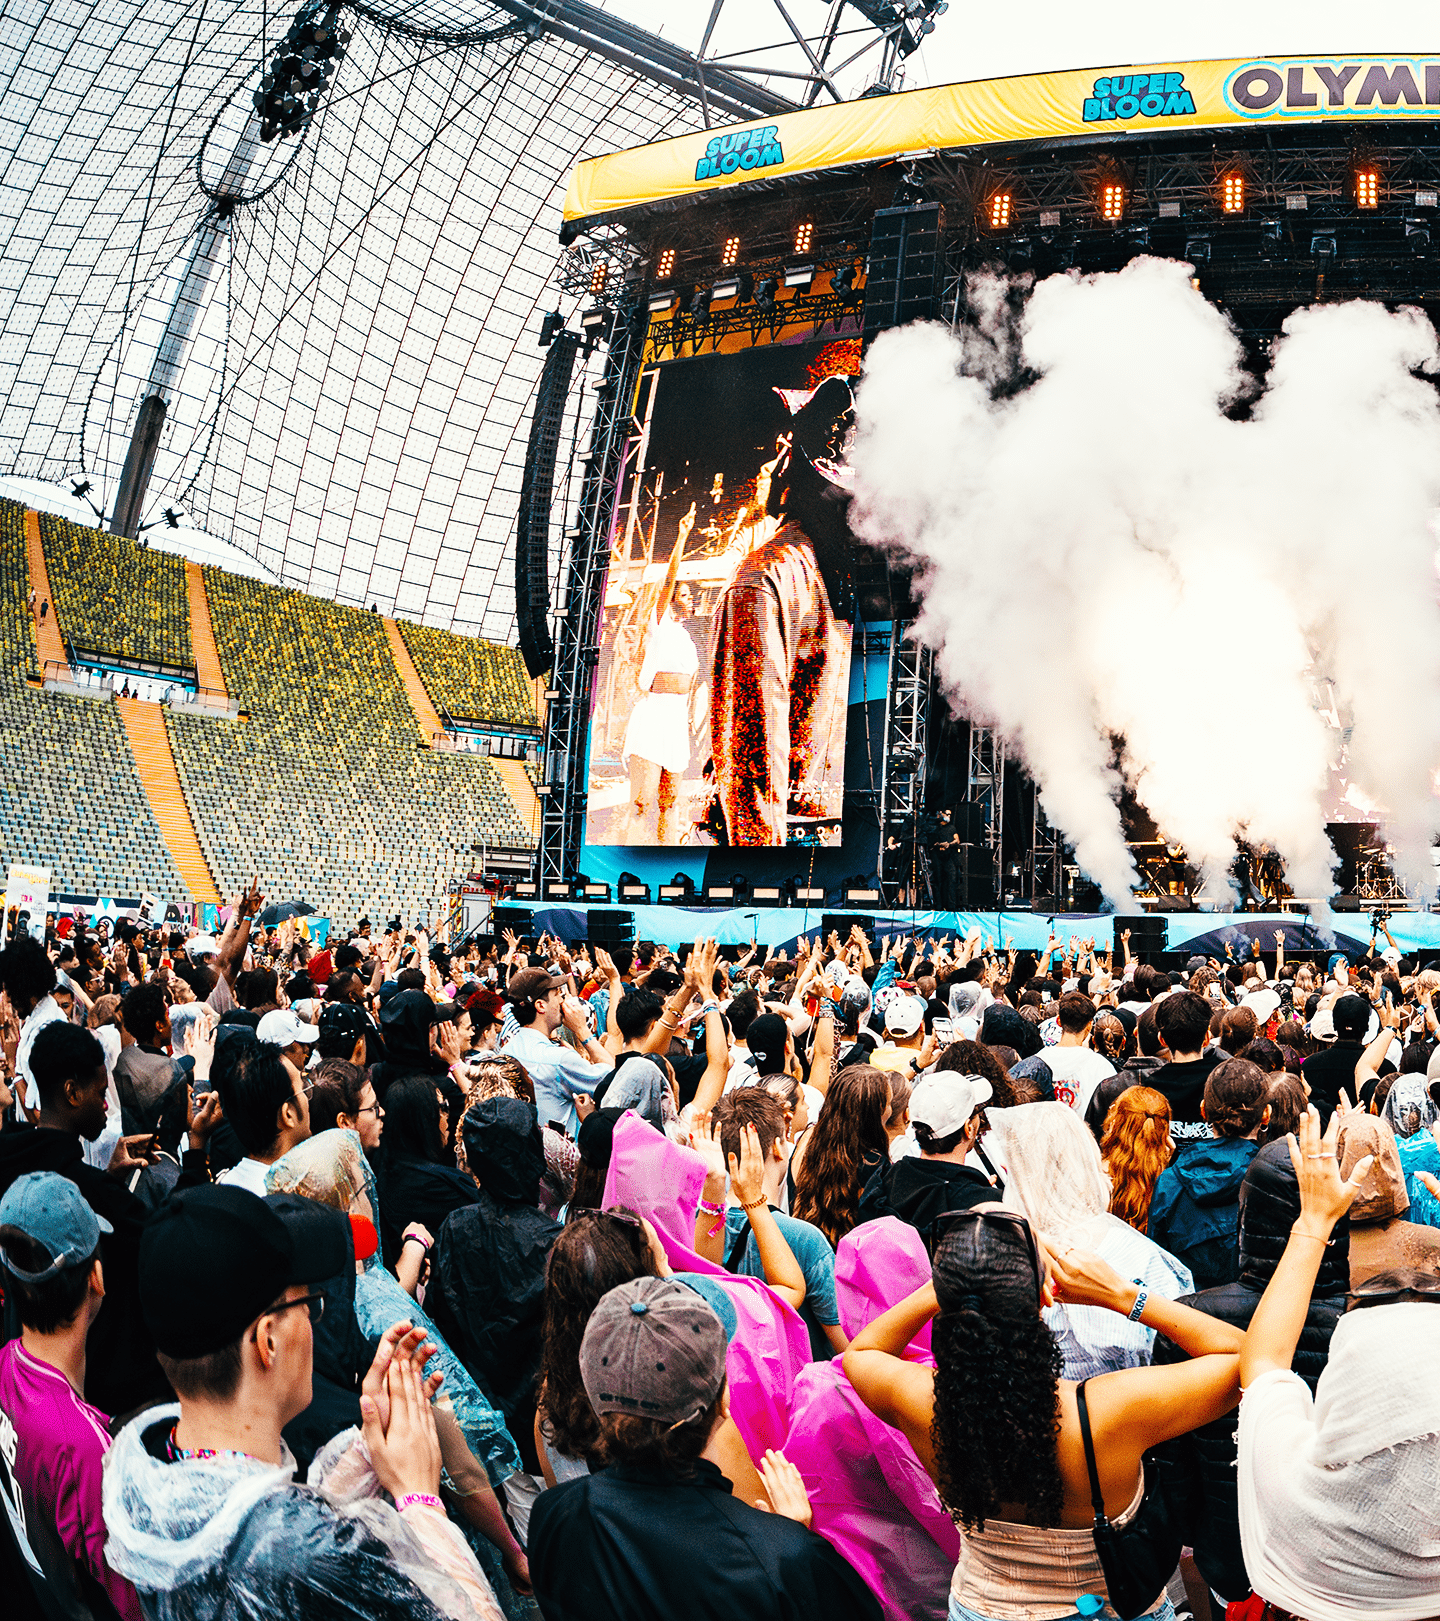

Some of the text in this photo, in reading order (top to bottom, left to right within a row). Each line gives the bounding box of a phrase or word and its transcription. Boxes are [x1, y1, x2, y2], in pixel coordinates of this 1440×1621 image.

[1093, 71, 1185, 96] SUPER
[1082, 86, 1196, 122] BLOOM
[705, 125, 780, 157] SUPER
[695, 143, 784, 181] BLOOM
